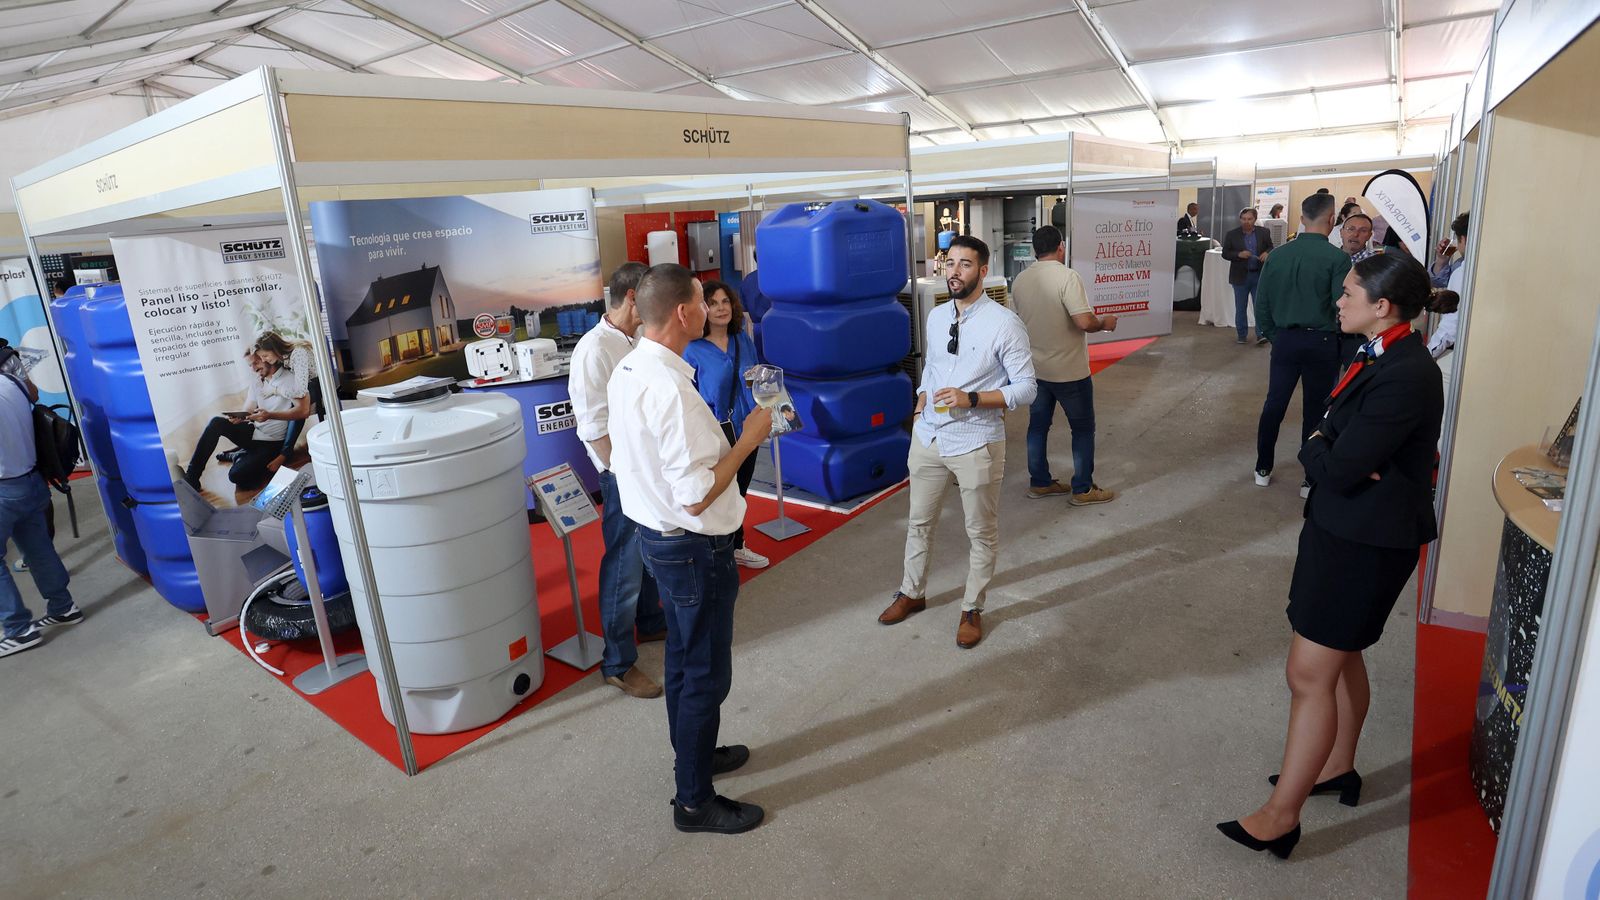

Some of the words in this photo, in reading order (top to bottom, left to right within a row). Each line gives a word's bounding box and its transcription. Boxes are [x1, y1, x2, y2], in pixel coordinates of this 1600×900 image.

[683, 127, 730, 143] SCHÜTZ
[96, 173, 118, 193] SCHÜTZ
[533, 225, 558, 233] ENERGY
[559, 223, 587, 231] SYSTEMS
[1095, 220, 1122, 234] calor
[1124, 220, 1133, 232] &
[350, 232, 391, 247] Tecnología
[393, 231, 410, 245] que
[413, 230, 433, 239] crea
[435, 225, 473, 239] espacio
[225, 252, 252, 262] ENERGY
[254, 250, 283, 260] SYSTEMS
[368, 249, 384, 263] para
[385, 246, 407, 258] vivir.
[1095, 242, 1133, 259] Alféa
[1136, 240, 1151, 256] Ai
[1095, 261, 1117, 271] Pareo
[1118, 261, 1125, 269] &
[1125, 259, 1151, 269] Maevo
[1095, 272, 1134, 284] Aéromax
[1136, 270, 1151, 280] VM
[138, 286, 172, 297] Sistemas
[173, 284, 183, 293] de
[184, 280, 223, 293] superficies
[224, 276, 255, 287] radiantes
[141, 294, 175, 307] Panel
[178, 292, 199, 303] liso
[213, 282, 283, 300] ¡Desenrollar,
[144, 306, 187, 319] colocar
[191, 303, 198, 314] y
[202, 299, 231, 312] listo!
[1096, 304, 1136, 313] REFRIGERANTE
[148, 324, 187, 338] Ejecución
[189, 320, 215, 333] rápida
[215, 320, 221, 328] y
[150, 333, 183, 346] sencilla,
[185, 329, 213, 340] incluso
[214, 329, 224, 337] en
[226, 325, 237, 334] los
[153, 341, 187, 356] espacios
[188, 339, 199, 349] de
[201, 334, 241, 348] geometría
[155, 350, 190, 364] irregular
[159, 360, 235, 378] www.schuetziberica.com
[540, 418, 575, 432] ENERGY
